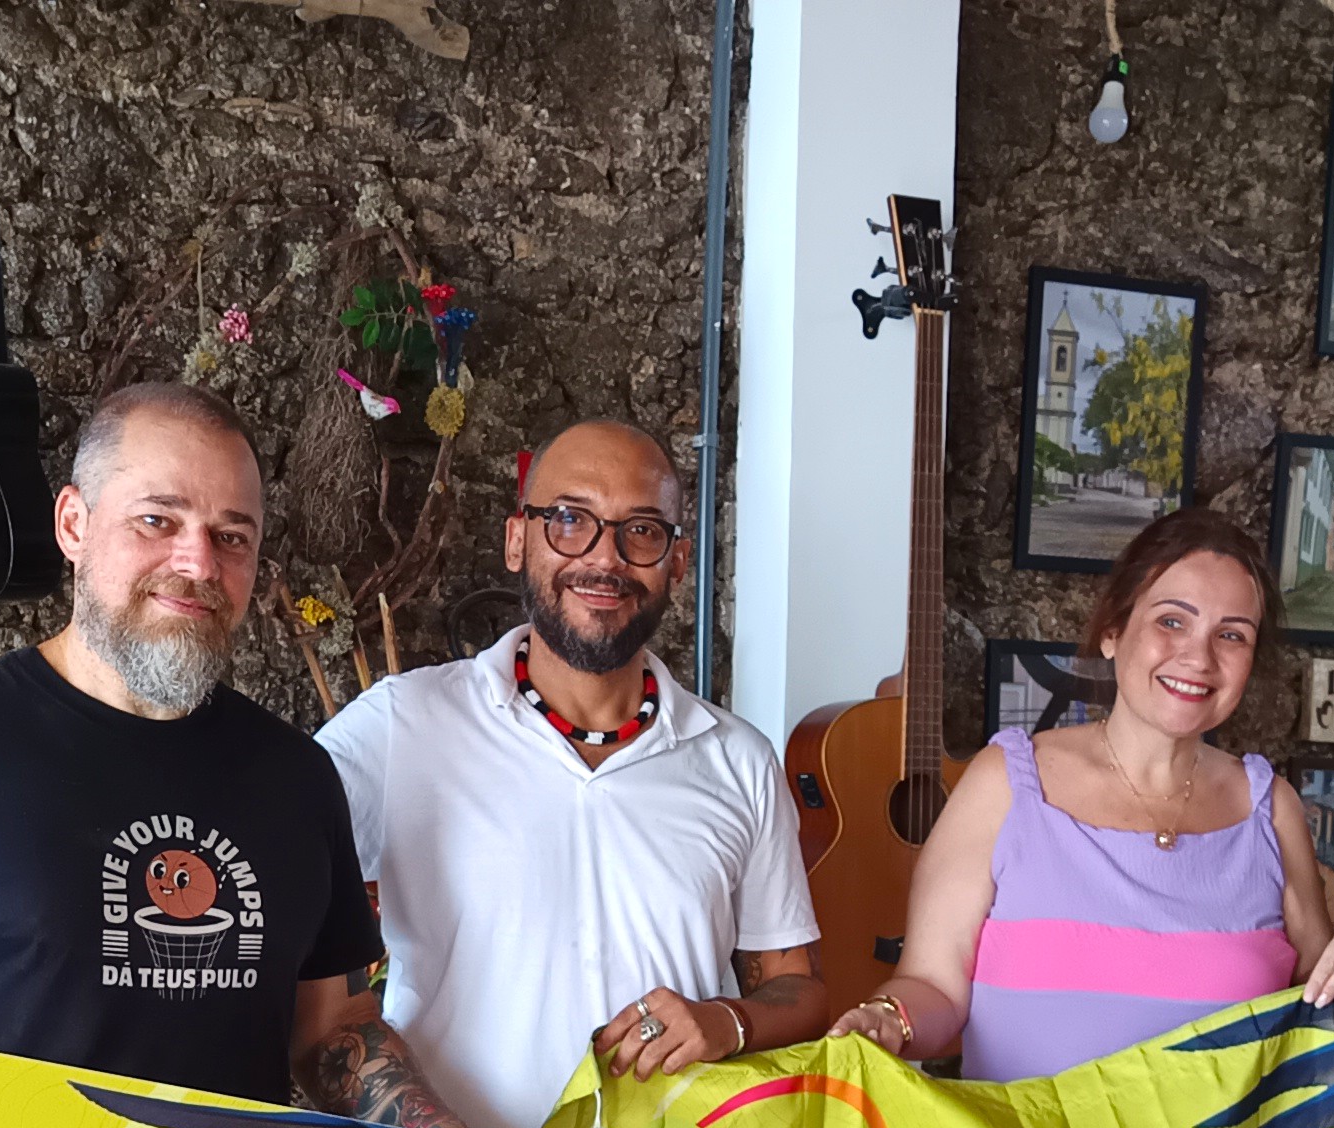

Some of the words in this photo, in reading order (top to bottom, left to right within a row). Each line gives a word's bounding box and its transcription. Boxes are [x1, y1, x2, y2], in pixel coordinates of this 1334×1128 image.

[113, 814, 195, 854] YOUR
[102, 853, 130, 924] GIVE
[200, 829, 264, 928] JUMPS
[102, 961, 134, 987] DÁ
[138, 968, 197, 989] TEUS
[201, 968, 258, 989] PULO
